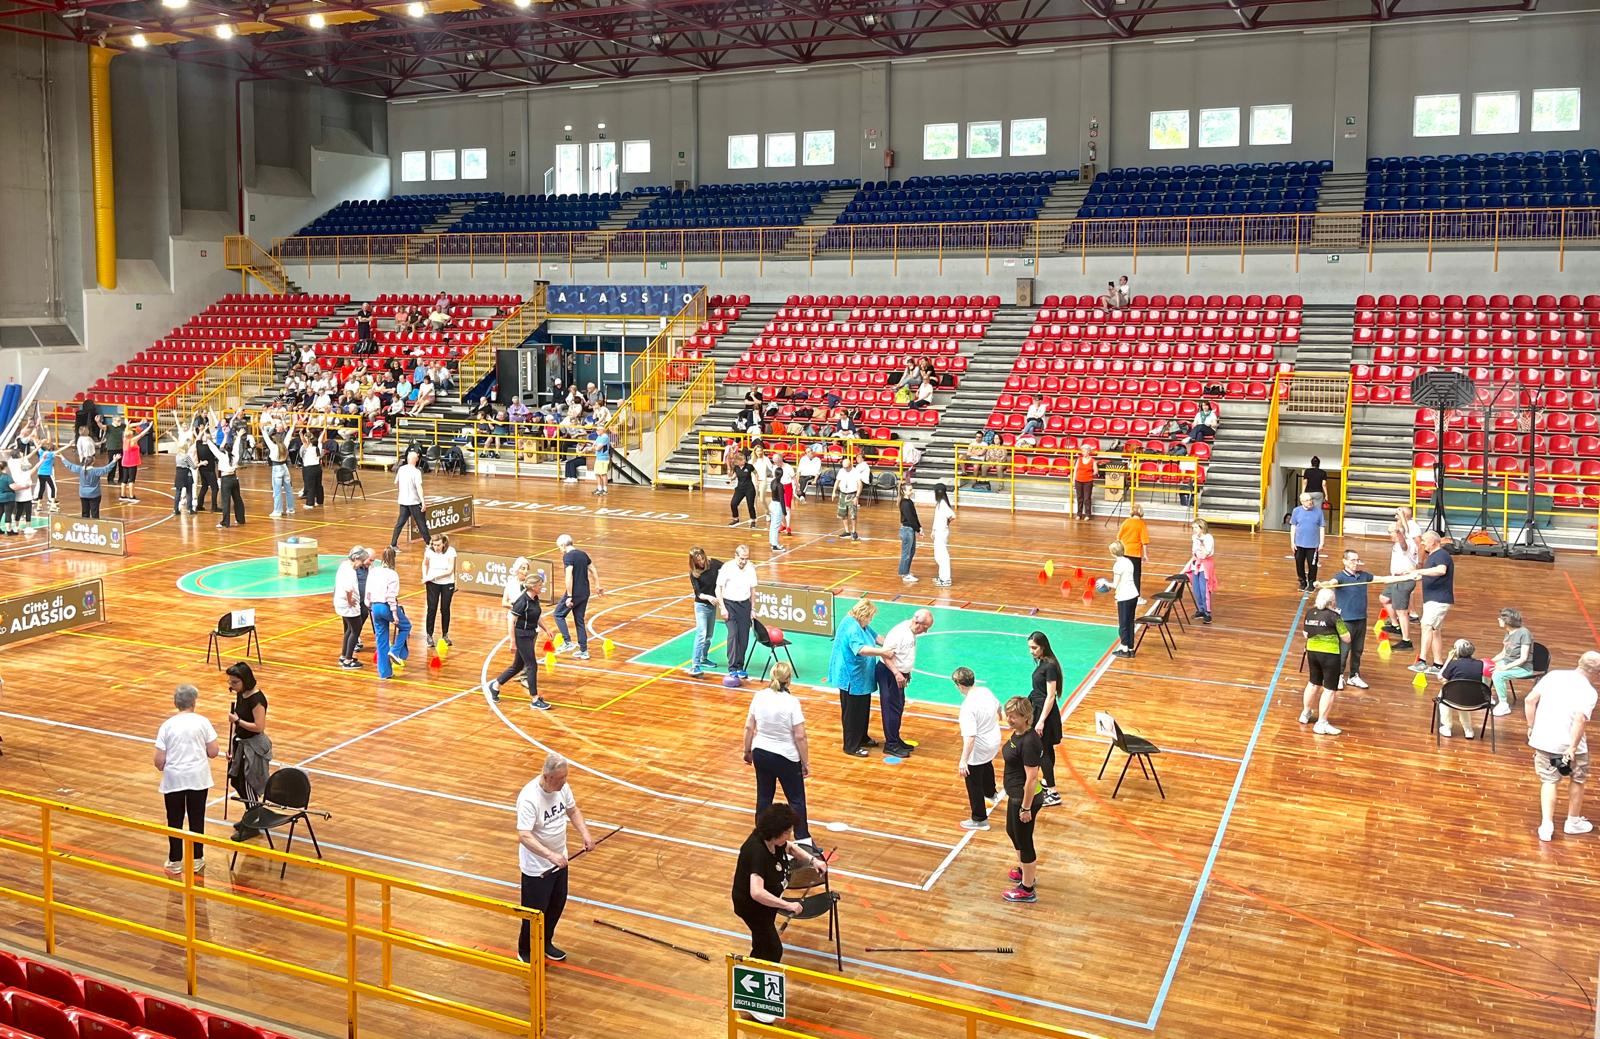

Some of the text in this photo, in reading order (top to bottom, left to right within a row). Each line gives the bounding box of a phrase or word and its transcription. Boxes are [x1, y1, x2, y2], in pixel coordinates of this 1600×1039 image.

[558, 292, 693, 303] ALASSIO
[446, 505, 454, 515] di
[64, 530, 107, 546] ALASSIO
[485, 561, 507, 574] Città
[23, 595, 64, 615] Città di
[781, 593, 793, 607] di
[10, 604, 77, 634] ALASSIO
[734, 998, 751, 1007] USCITA
[756, 1003, 783, 1014] EMERGENZA
